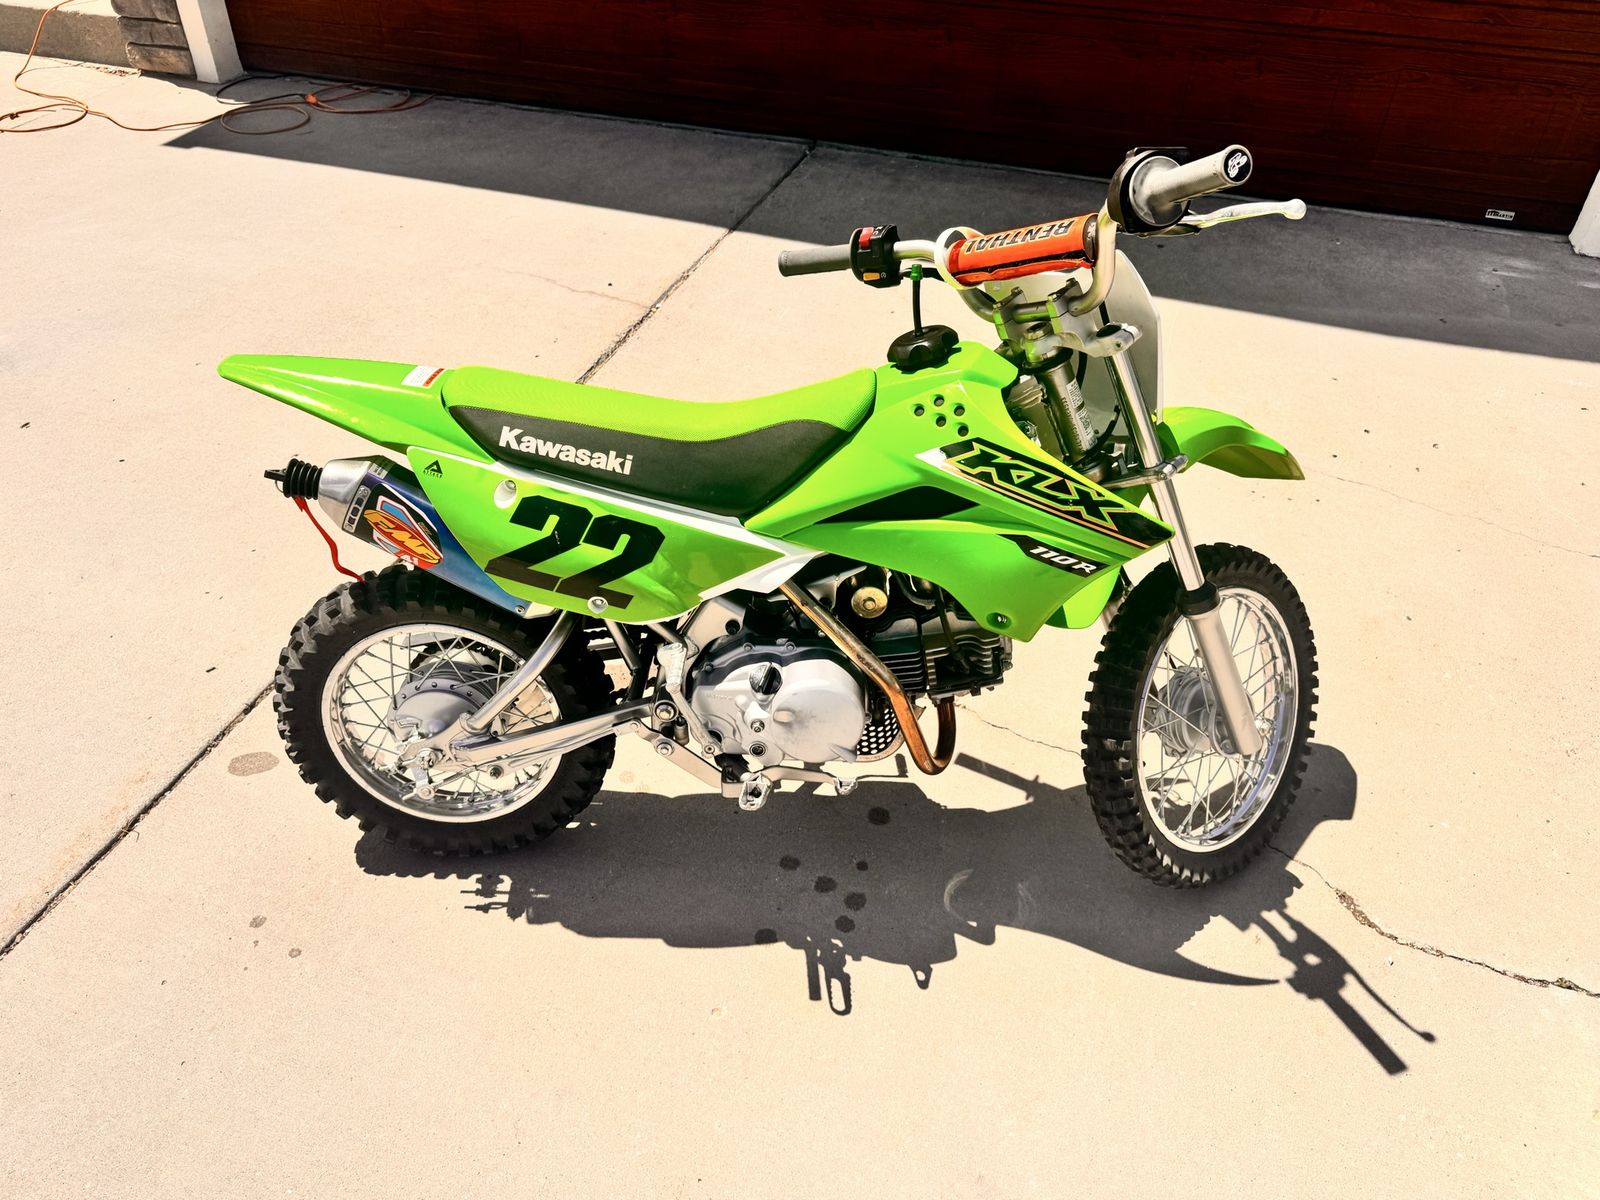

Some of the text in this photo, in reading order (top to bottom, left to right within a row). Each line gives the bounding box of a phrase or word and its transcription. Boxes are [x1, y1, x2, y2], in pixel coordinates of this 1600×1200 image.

[964, 218, 1075, 254] RENTHAL
[499, 425, 634, 476] Kawasaki
[945, 441, 1136, 531] KLX
[364, 510, 441, 564] FMF
[484, 495, 665, 610] 22
